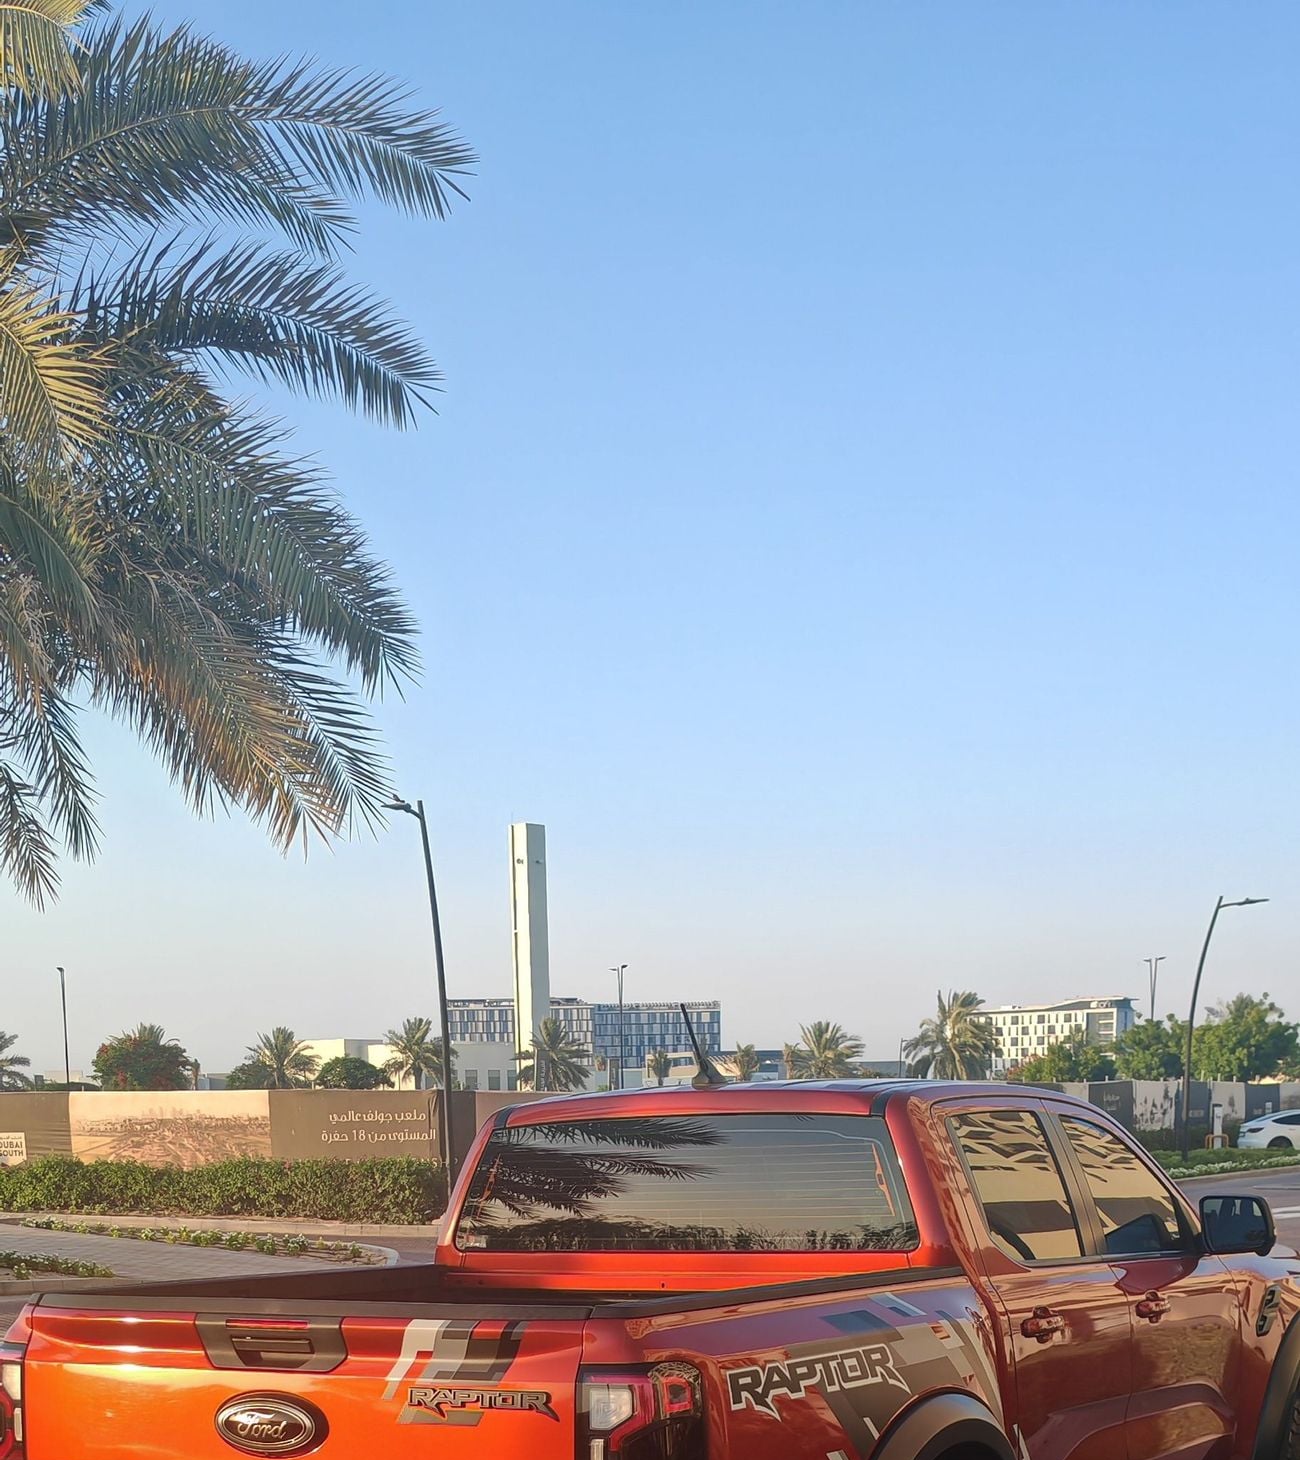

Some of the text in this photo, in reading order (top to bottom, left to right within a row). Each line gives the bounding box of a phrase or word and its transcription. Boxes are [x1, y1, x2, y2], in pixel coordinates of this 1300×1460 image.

[329, 1109, 427, 1125] ملعب جولف عالمي
[321, 1129, 436, 1144] المستوى من 18 حفرة
[726, 1343, 912, 1423] RAPTOR
[408, 1387, 561, 1423] RAPTOR
[228, 1411, 287, 1440] Ford
